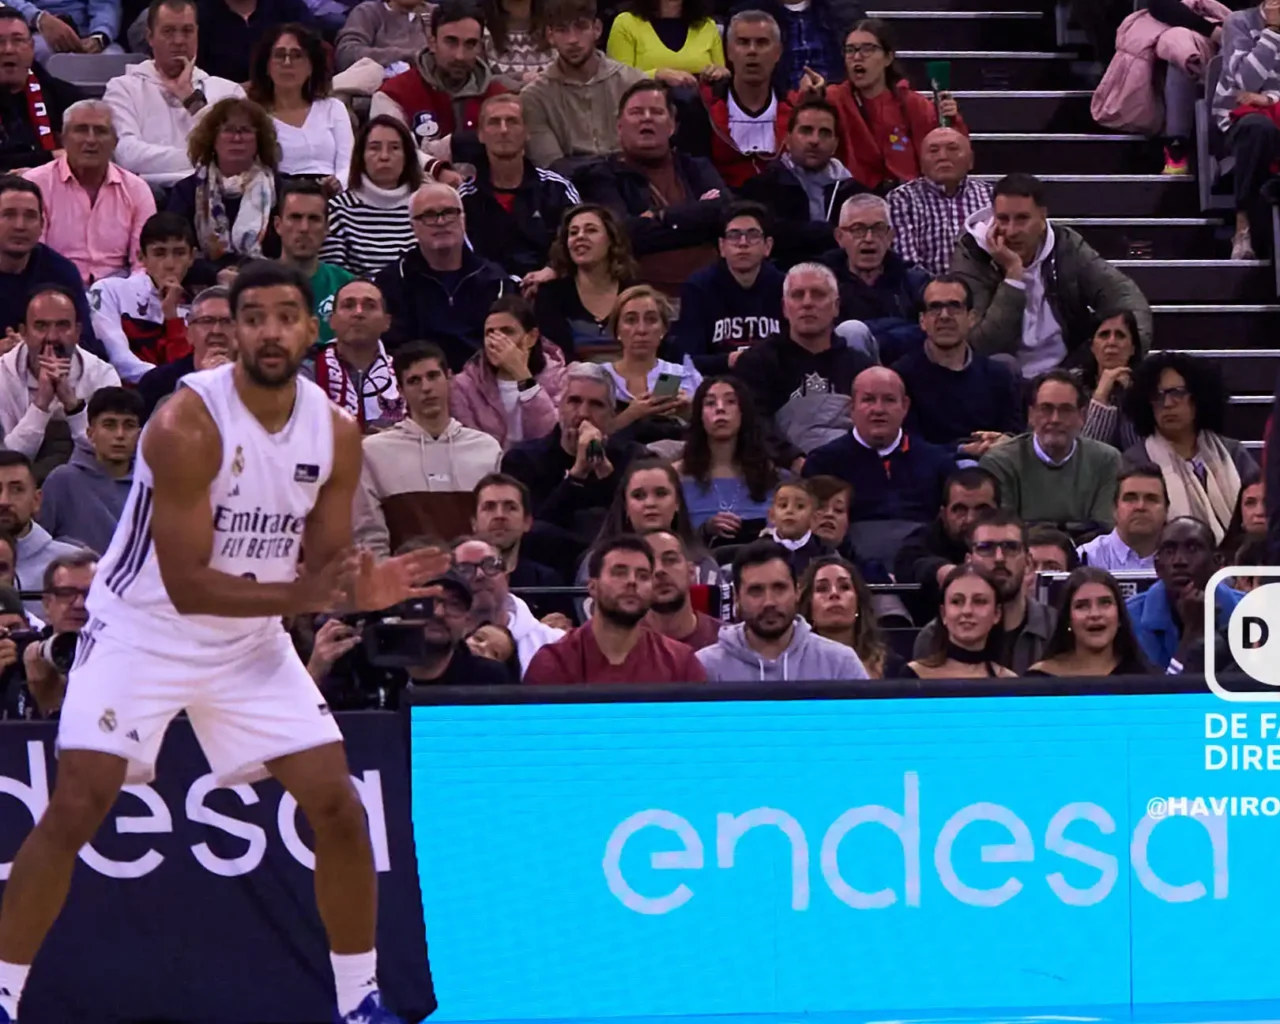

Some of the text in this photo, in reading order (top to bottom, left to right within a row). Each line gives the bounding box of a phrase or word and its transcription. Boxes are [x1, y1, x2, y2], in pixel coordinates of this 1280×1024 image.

[712, 316, 781, 344] BOSTON
[212, 505, 306, 536] Emirate
[222, 537, 294, 559] FLY BETTER
[602, 771, 1230, 914] endesa
